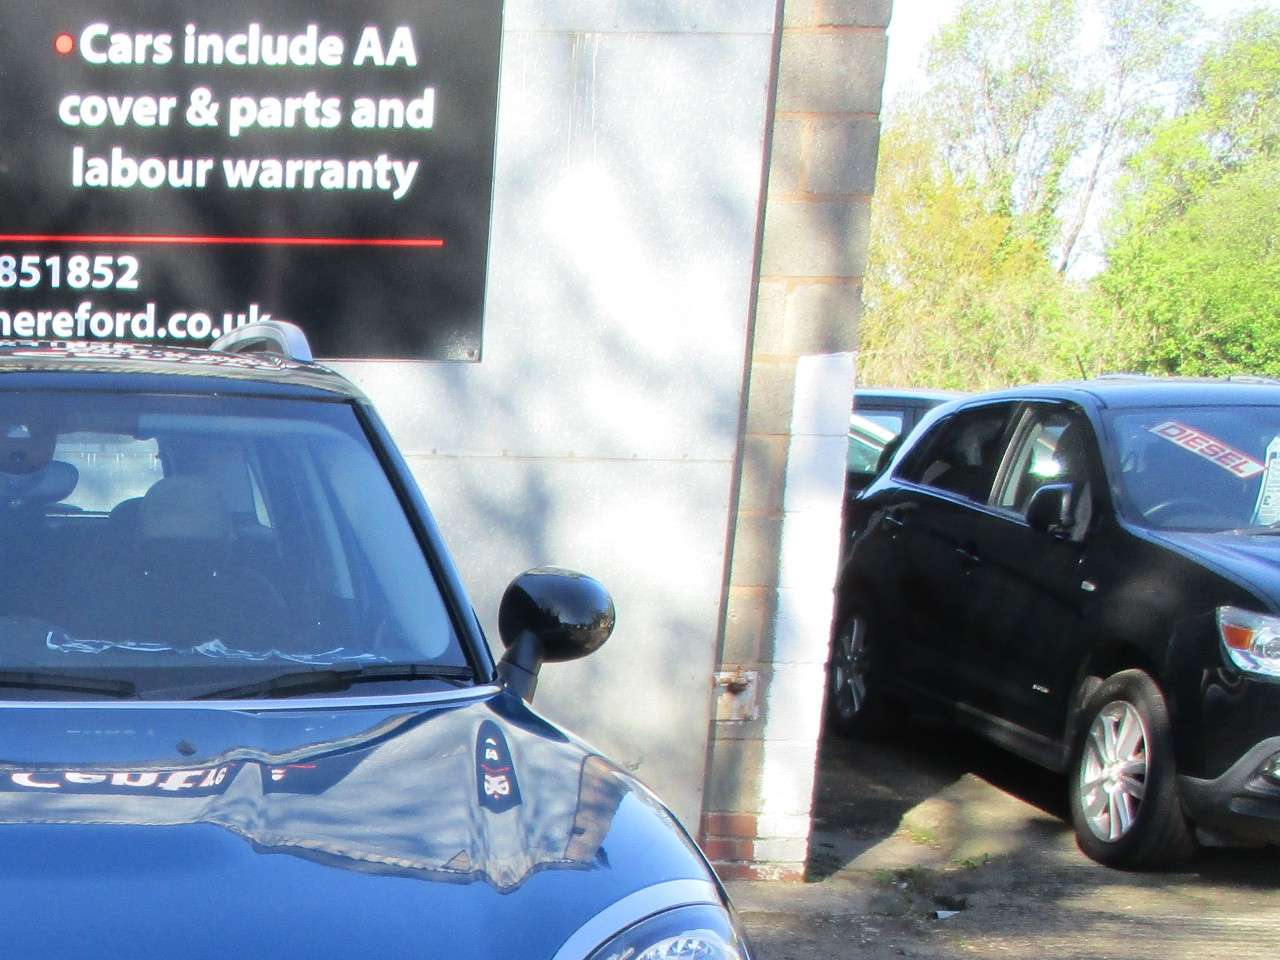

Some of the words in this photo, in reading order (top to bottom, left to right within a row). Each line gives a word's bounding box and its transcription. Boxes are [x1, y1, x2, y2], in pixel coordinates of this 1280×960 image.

[79, 22, 173, 65] Cars
[184, 23, 344, 66] include
[353, 25, 418, 67] AA
[58, 94, 177, 127] cover
[186, 87, 219, 128] &
[229, 89, 342, 137] parts
[351, 87, 436, 129] and
[72, 146, 213, 188] labour
[223, 153, 419, 200] warranty
[1159, 423, 1249, 474] DIESEL
